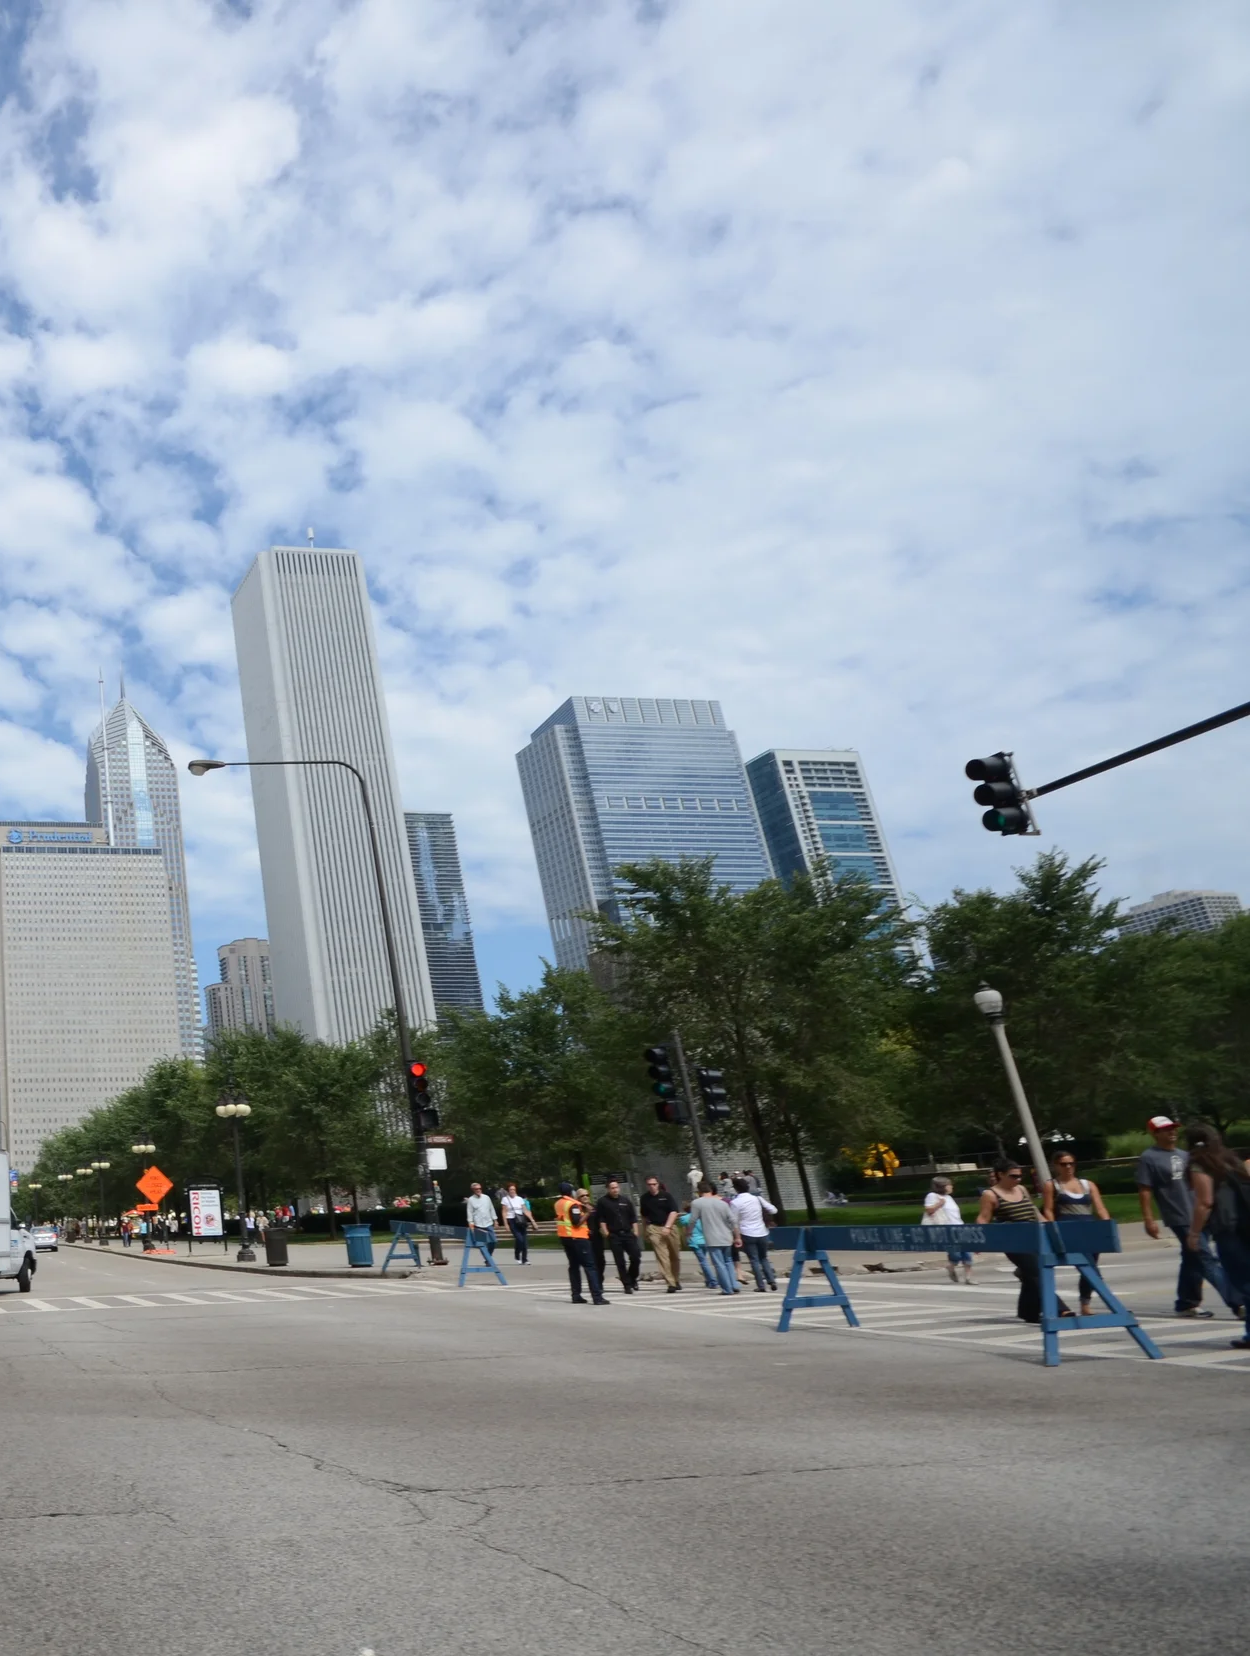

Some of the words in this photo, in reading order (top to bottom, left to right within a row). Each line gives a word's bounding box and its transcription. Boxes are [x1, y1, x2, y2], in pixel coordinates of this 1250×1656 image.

[29, 830, 93, 842] Prudential
[191, 1191, 203, 1236] RICOH
[850, 1227, 880, 1243] POLICE
[927, 1226, 948, 1242] NOT
[950, 1226, 986, 1243] CROSS
